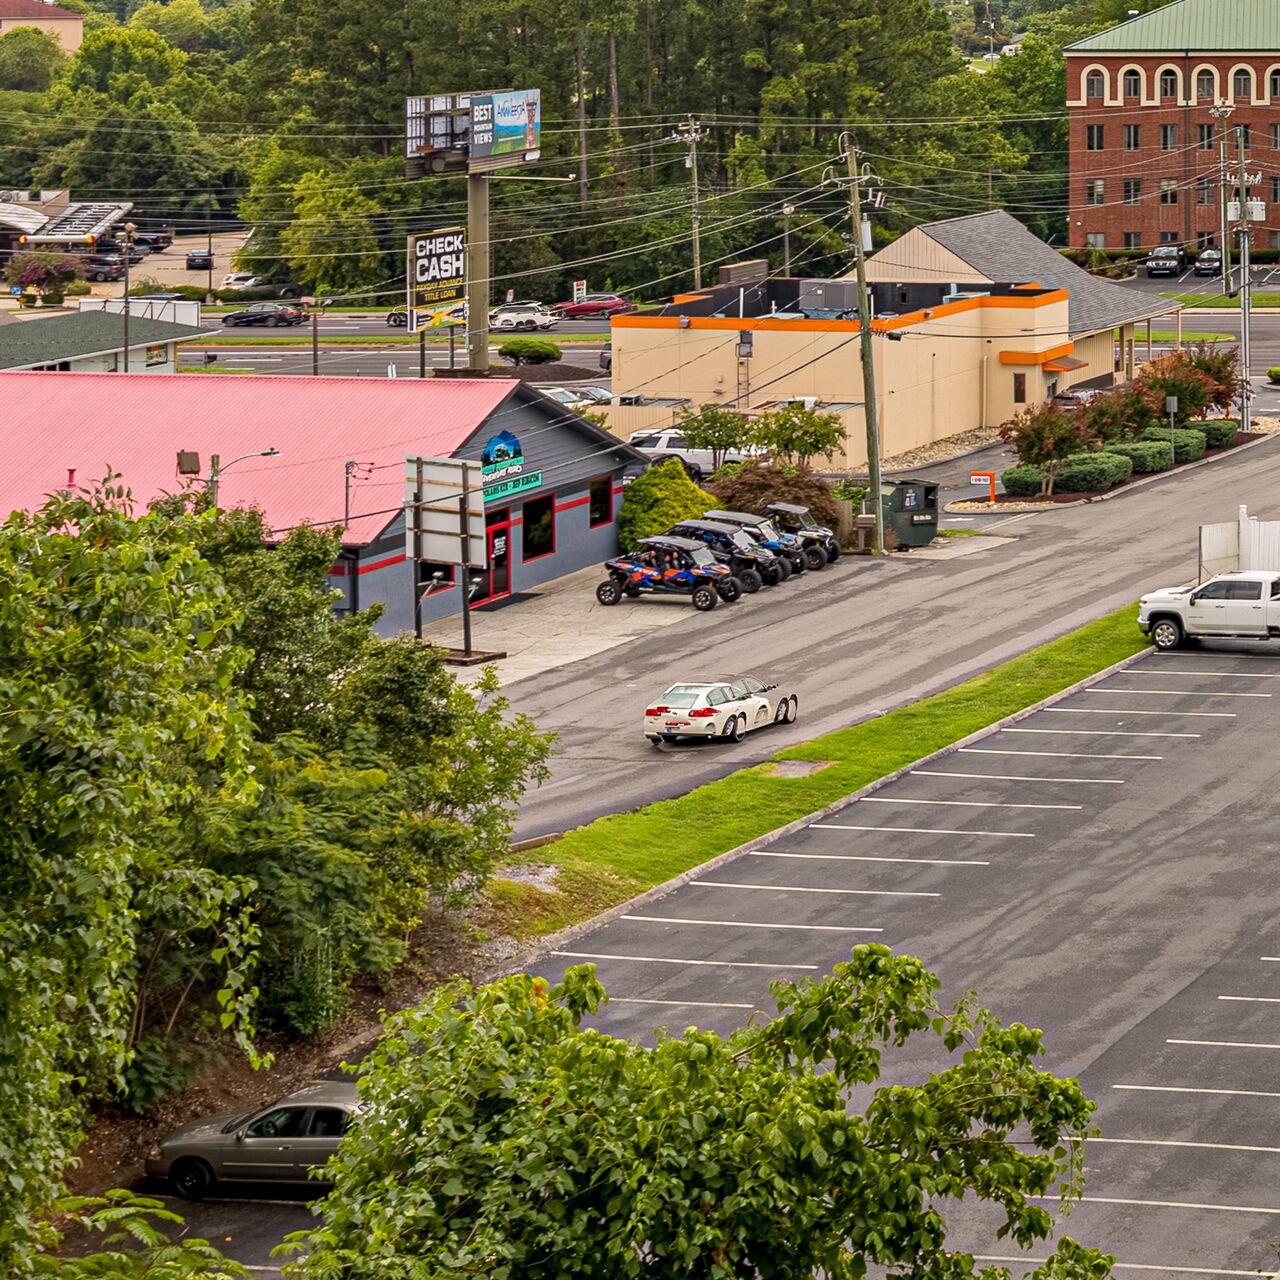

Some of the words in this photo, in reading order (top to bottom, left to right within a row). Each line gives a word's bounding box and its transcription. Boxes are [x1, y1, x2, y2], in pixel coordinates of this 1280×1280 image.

[474, 104, 492, 122] BEST
[474, 132, 492, 144] VIEWS
[416, 234, 463, 257] CHECK
[416, 252, 464, 282] CASH
[424, 291, 439, 301] TITLE
[440, 288, 456, 299] LOAN
